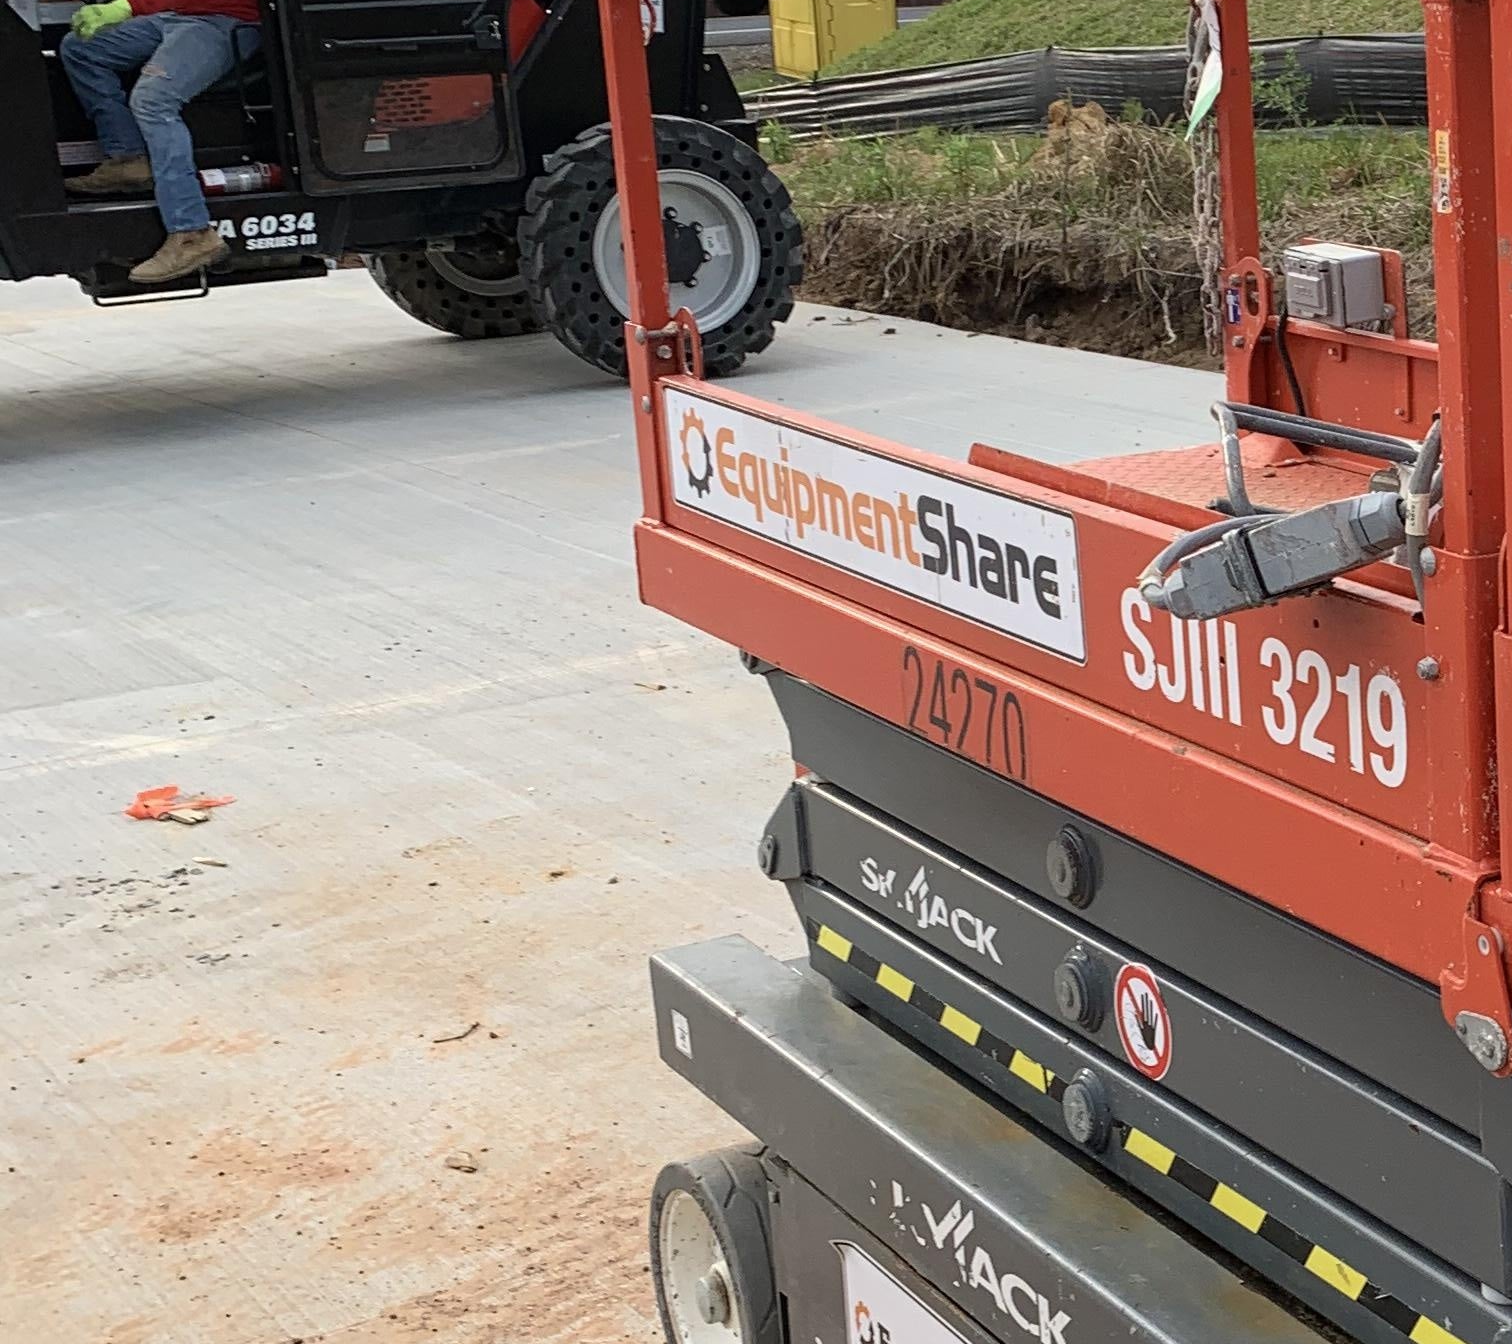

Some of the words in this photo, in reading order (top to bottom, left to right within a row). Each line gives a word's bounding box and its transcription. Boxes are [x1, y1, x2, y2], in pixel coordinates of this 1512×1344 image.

[241, 211, 317, 237] 6034
[245, 235, 299, 251] SERIES
[715, 426, 1063, 621] EquipmentShare
[902, 645, 1029, 782] 24270
[1259, 637, 1408, 789] 3219
